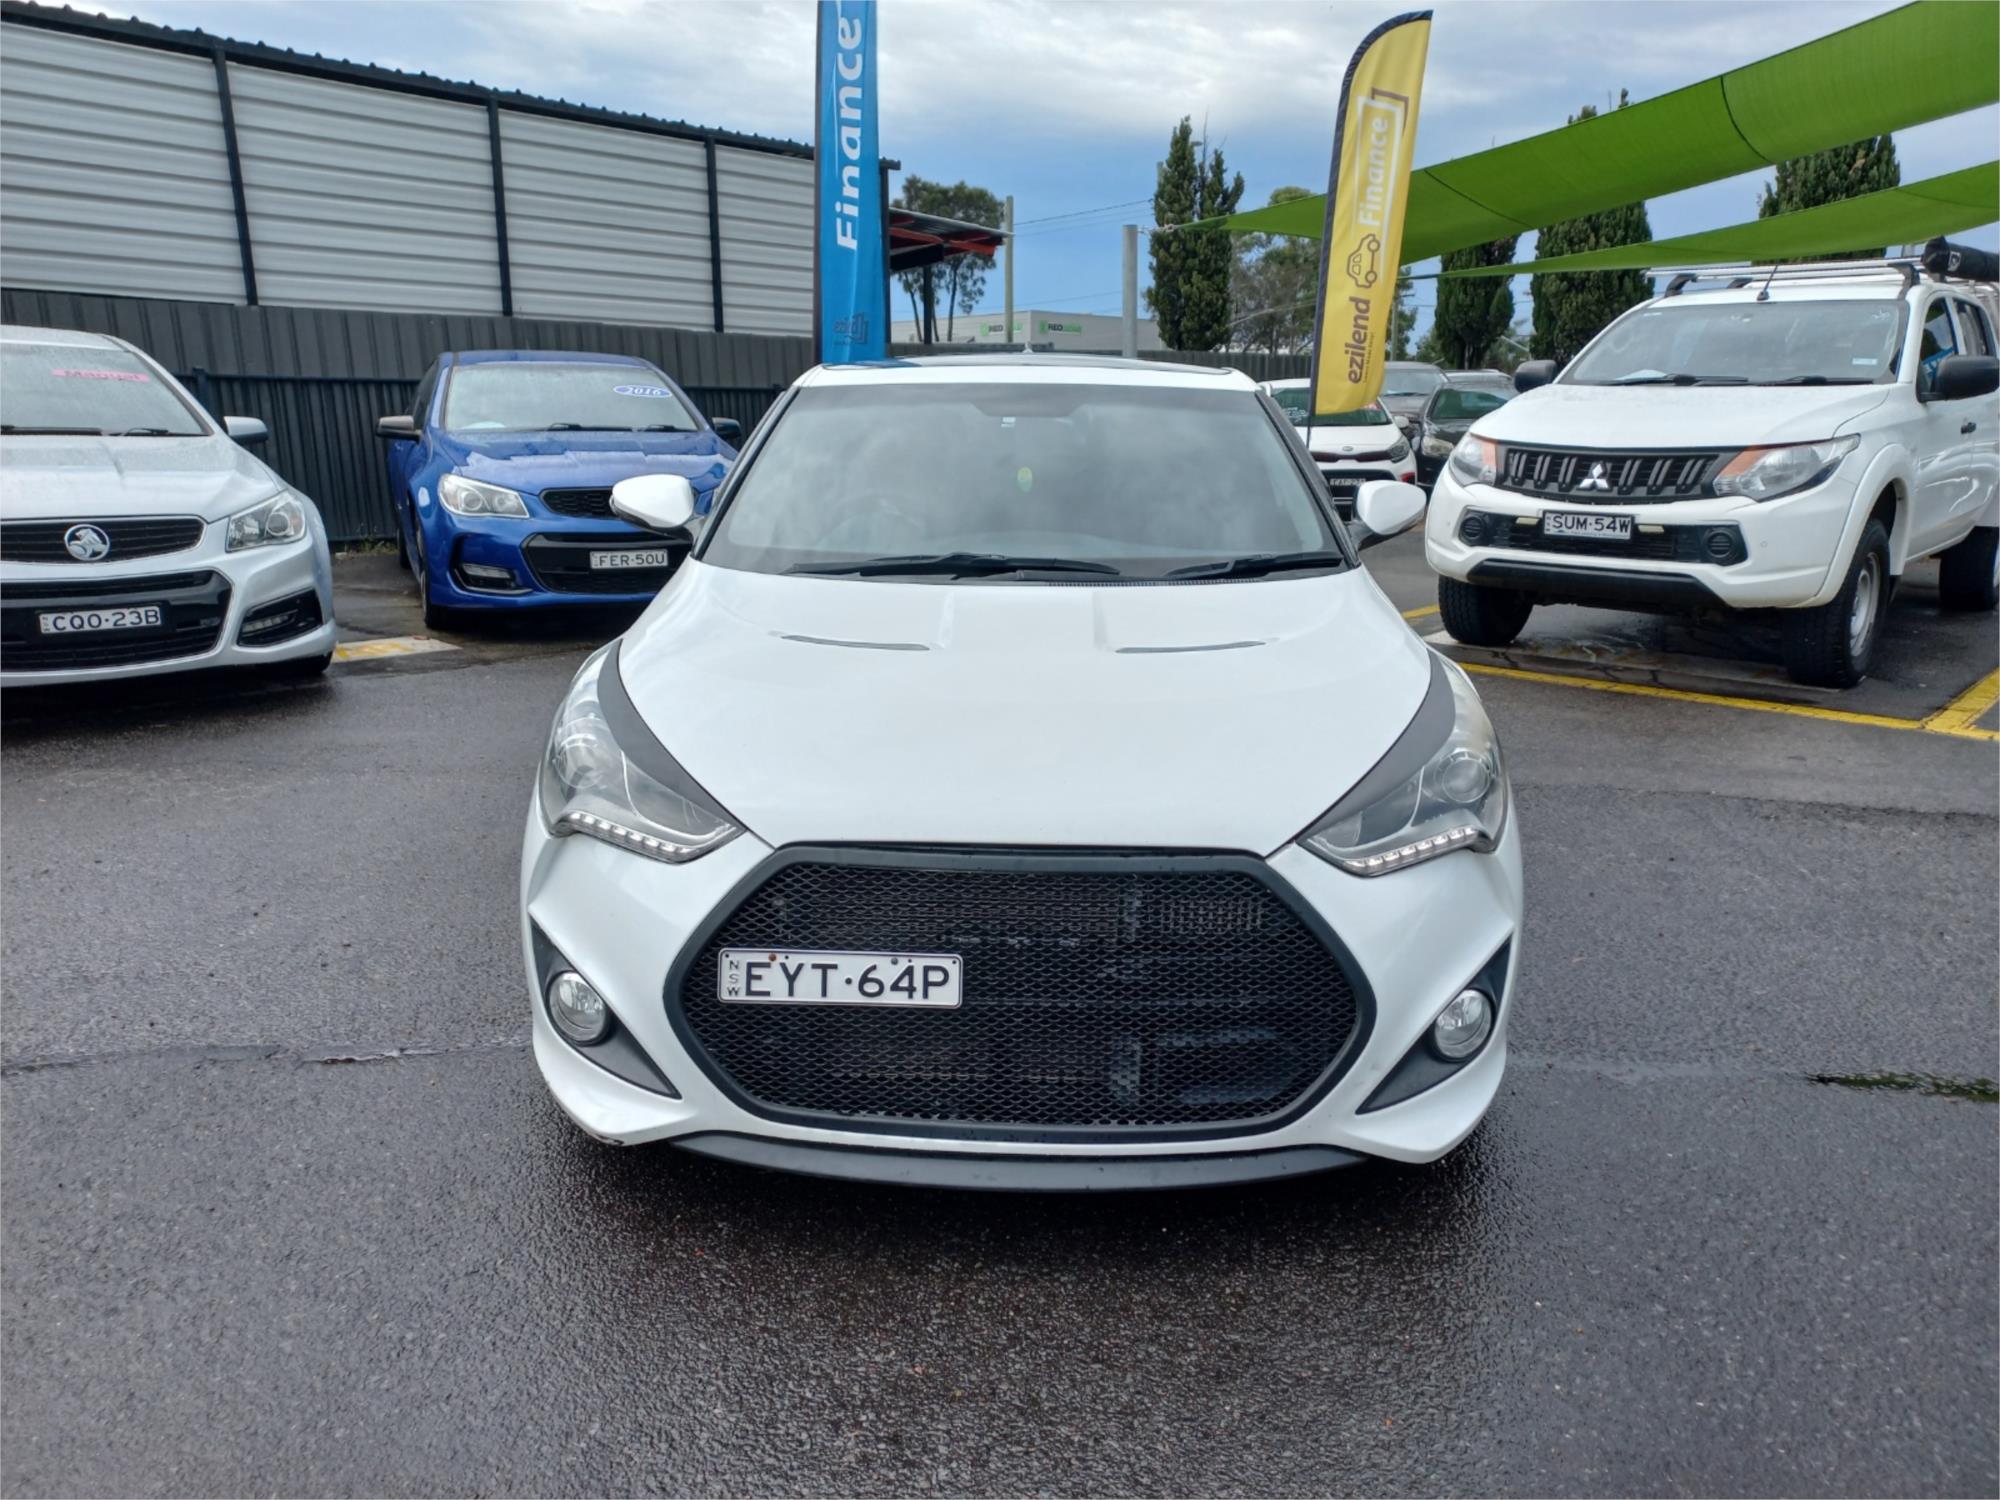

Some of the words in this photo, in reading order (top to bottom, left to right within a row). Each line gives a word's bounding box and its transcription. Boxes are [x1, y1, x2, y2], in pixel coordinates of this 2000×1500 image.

[835, 16, 863, 251] Finance
[1358, 116, 1389, 227] Finance
[1348, 295, 1371, 384] ezilend
